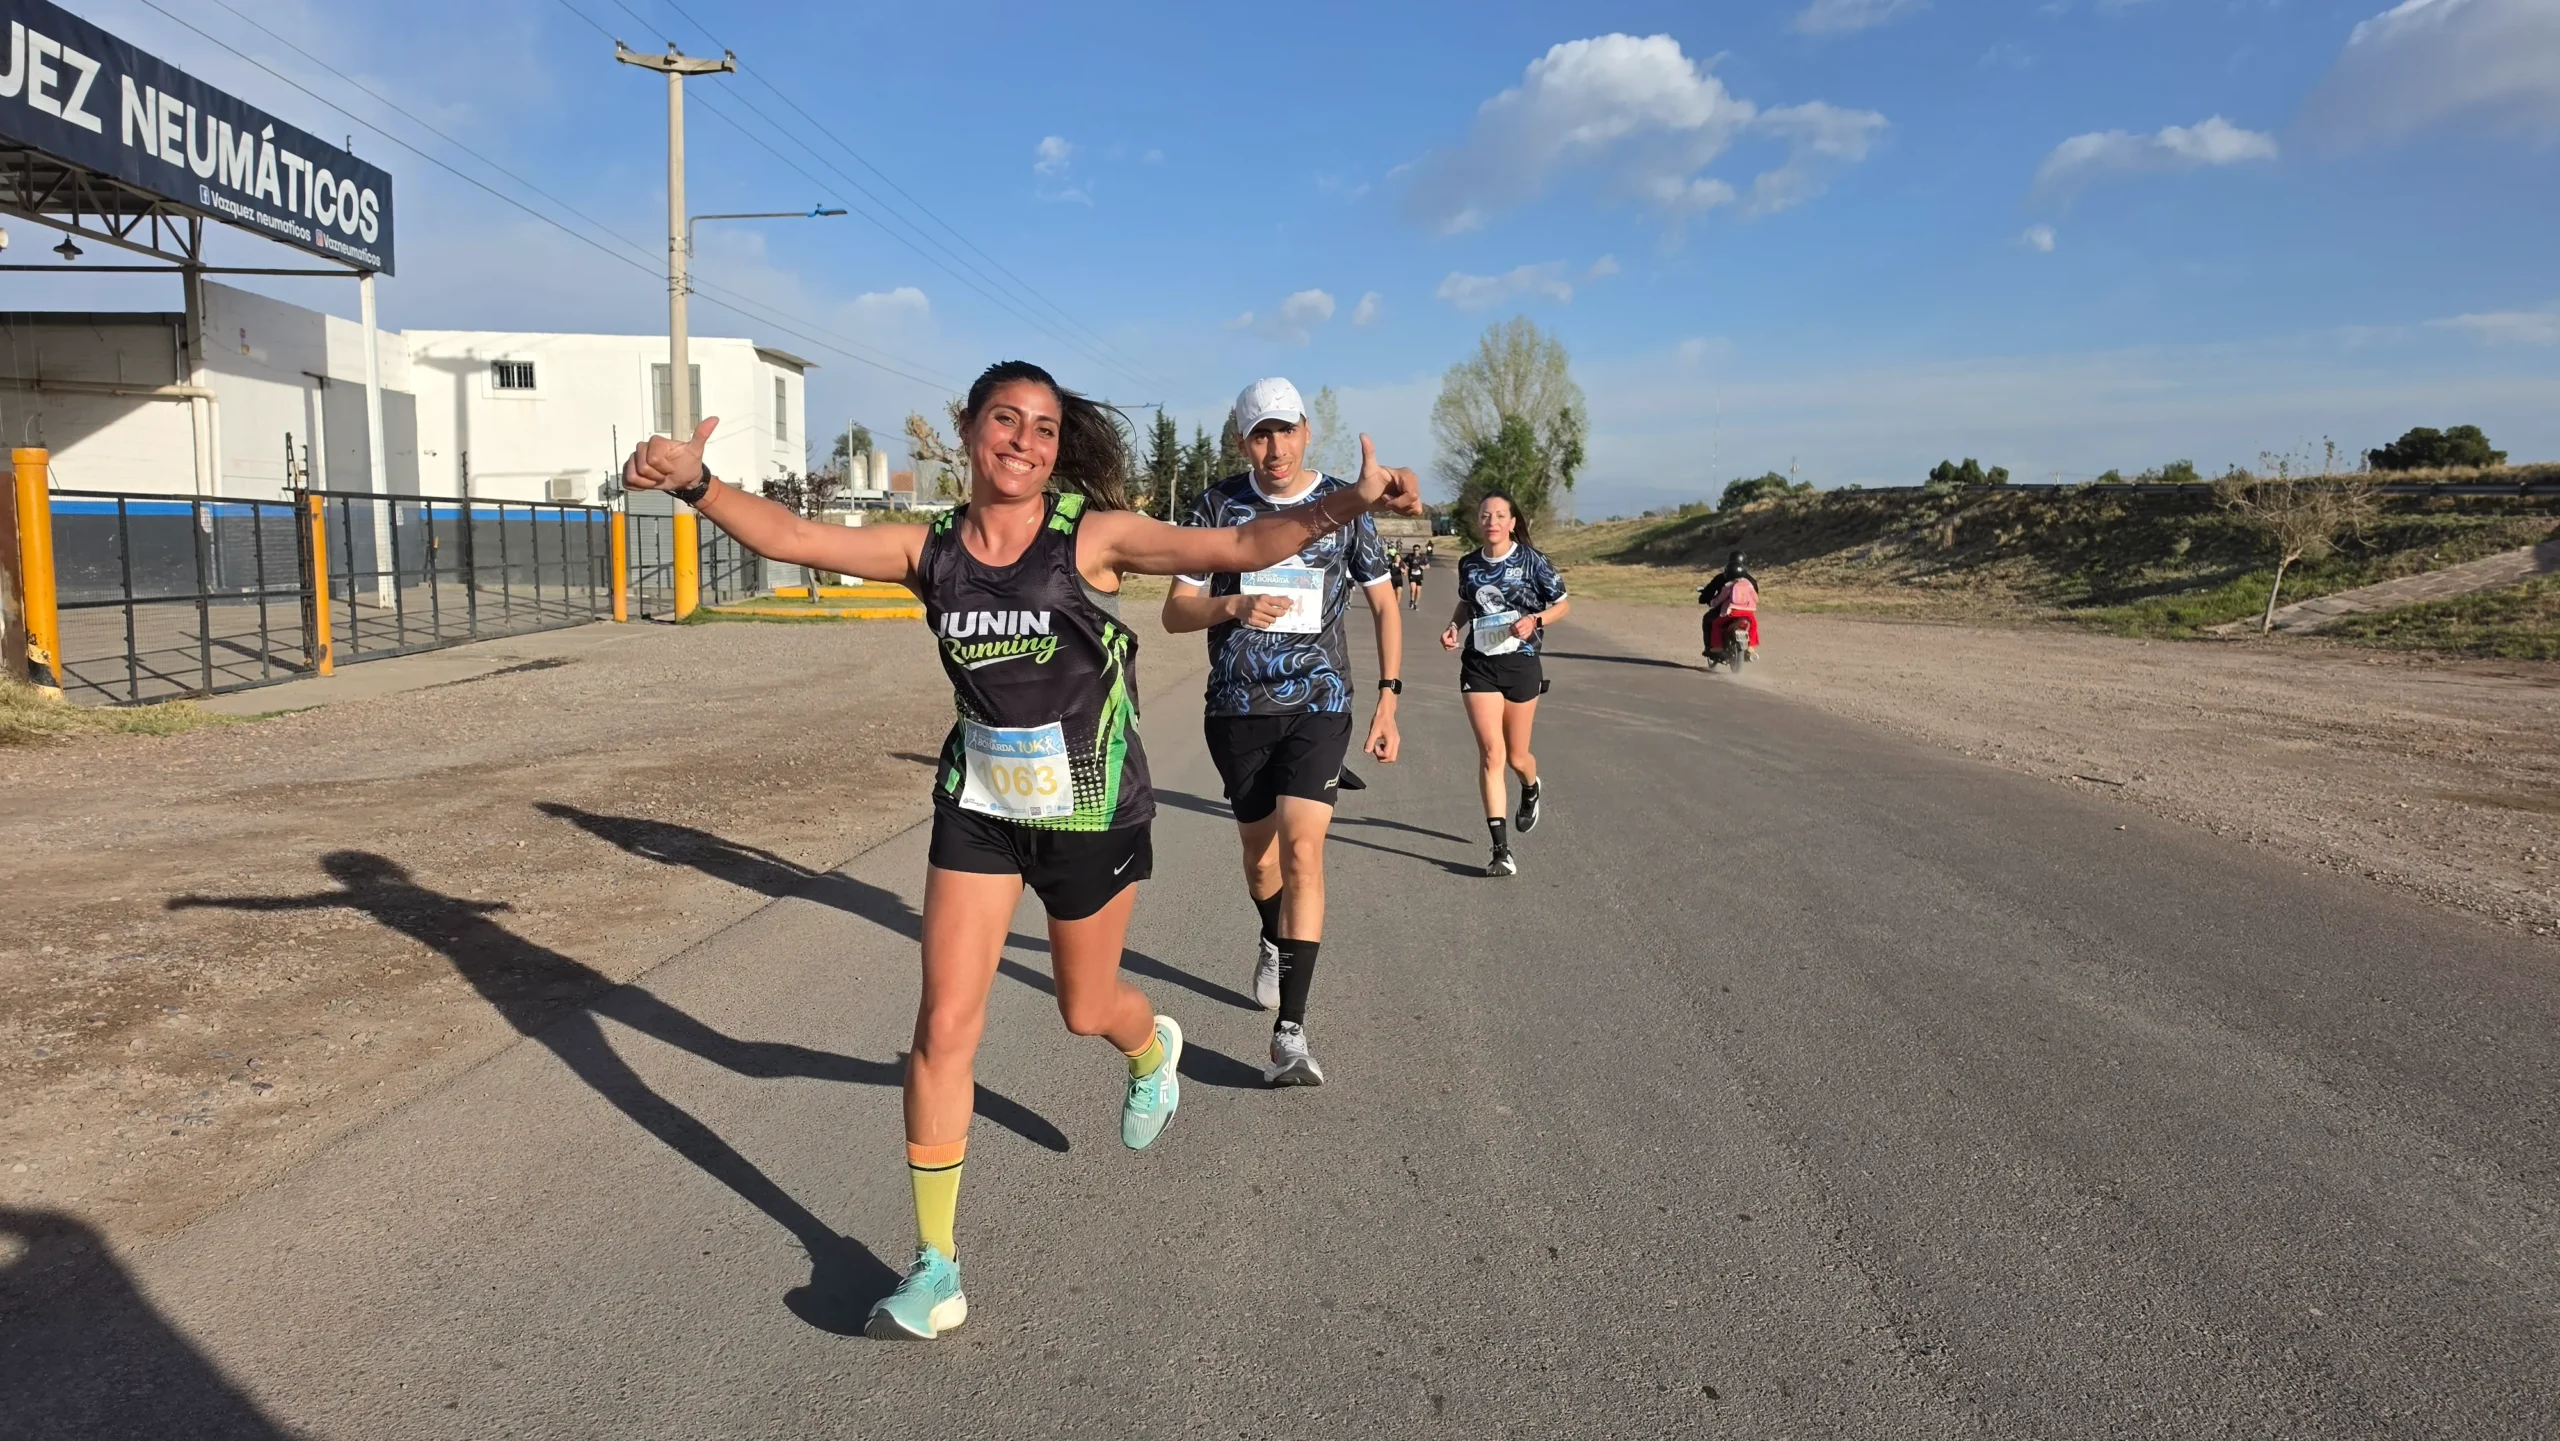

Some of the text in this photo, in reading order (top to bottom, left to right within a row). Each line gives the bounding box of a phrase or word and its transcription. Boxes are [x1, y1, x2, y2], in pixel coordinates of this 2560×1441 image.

[121, 74, 380, 244] NEUMÁTICOS
[211, 190, 312, 242] Vazquez neumaticos
[323, 233, 381, 267] Vazneumaticos
[938, 610, 1051, 639] JUNIN
[942, 633, 1059, 664] Running
[977, 761, 1058, 797] 1063
[1159, 1060, 1169, 1104] FILA
